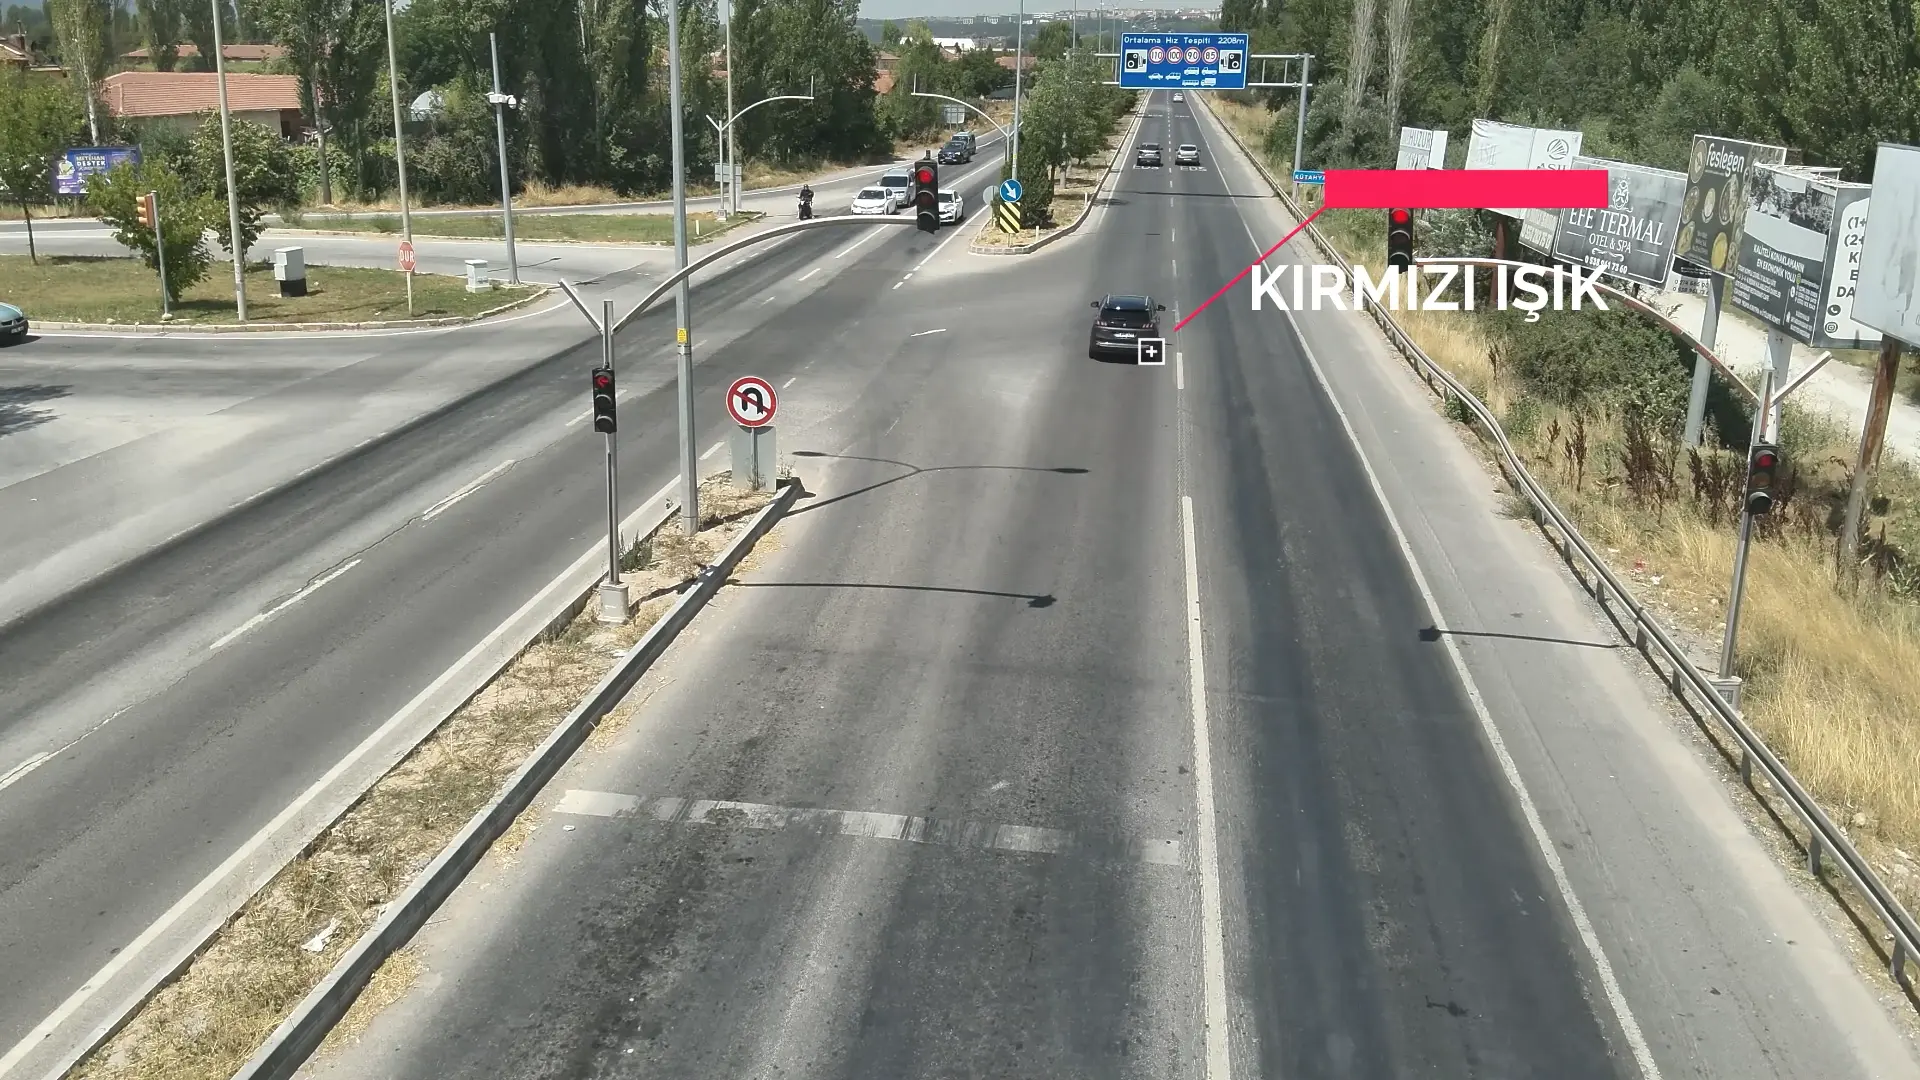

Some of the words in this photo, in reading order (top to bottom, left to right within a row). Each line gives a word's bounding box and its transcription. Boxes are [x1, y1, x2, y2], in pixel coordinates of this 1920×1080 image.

[1124, 36, 1161, 44] Ortalama
[1183, 37, 1211, 45] Tespiti
[1217, 37, 1245, 45] 2208m
[1151, 51, 1162, 60] 110
[1169, 51, 1180, 60] 100
[1187, 51, 1198, 60] 90
[1205, 51, 1216, 60] 85
[1706, 143, 1745, 178] fesleğen
[1568, 208, 1597, 229] EFE
[1599, 209, 1664, 246] TERMAL
[1588, 233, 1609, 248] OTEL
[1609, 237, 1616, 250] &
[1616, 239, 1632, 254] SPA
[400, 249, 415, 263] DUR
